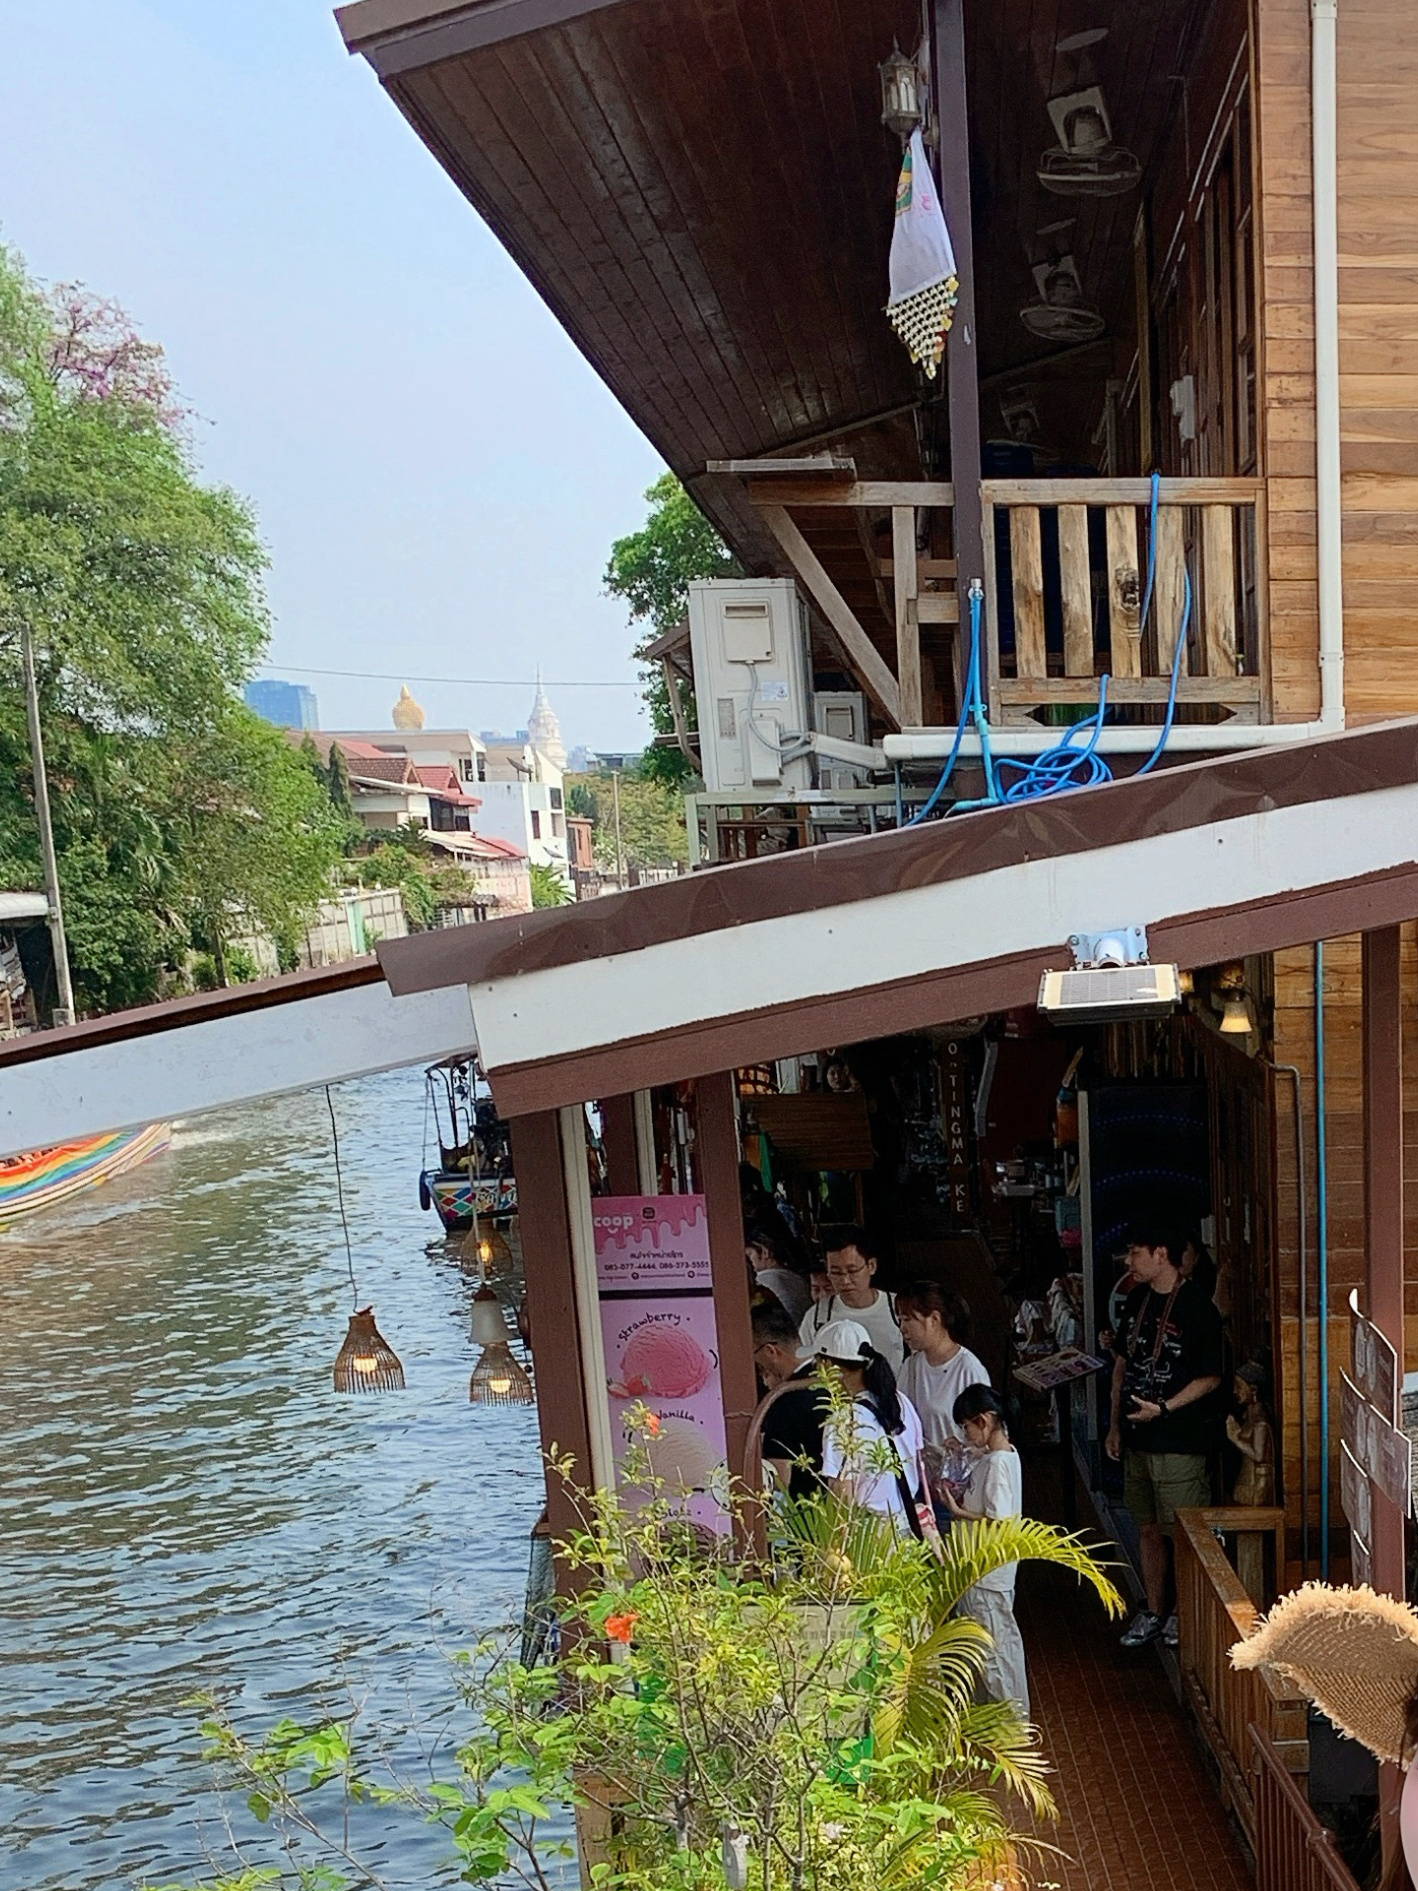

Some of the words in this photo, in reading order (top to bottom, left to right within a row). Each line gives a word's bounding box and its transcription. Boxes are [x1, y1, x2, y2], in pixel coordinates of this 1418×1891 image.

[593, 1215, 634, 1230] coop
[618, 1312, 681, 1341] Strawberry
[656, 1409, 695, 1422] Vanilla
